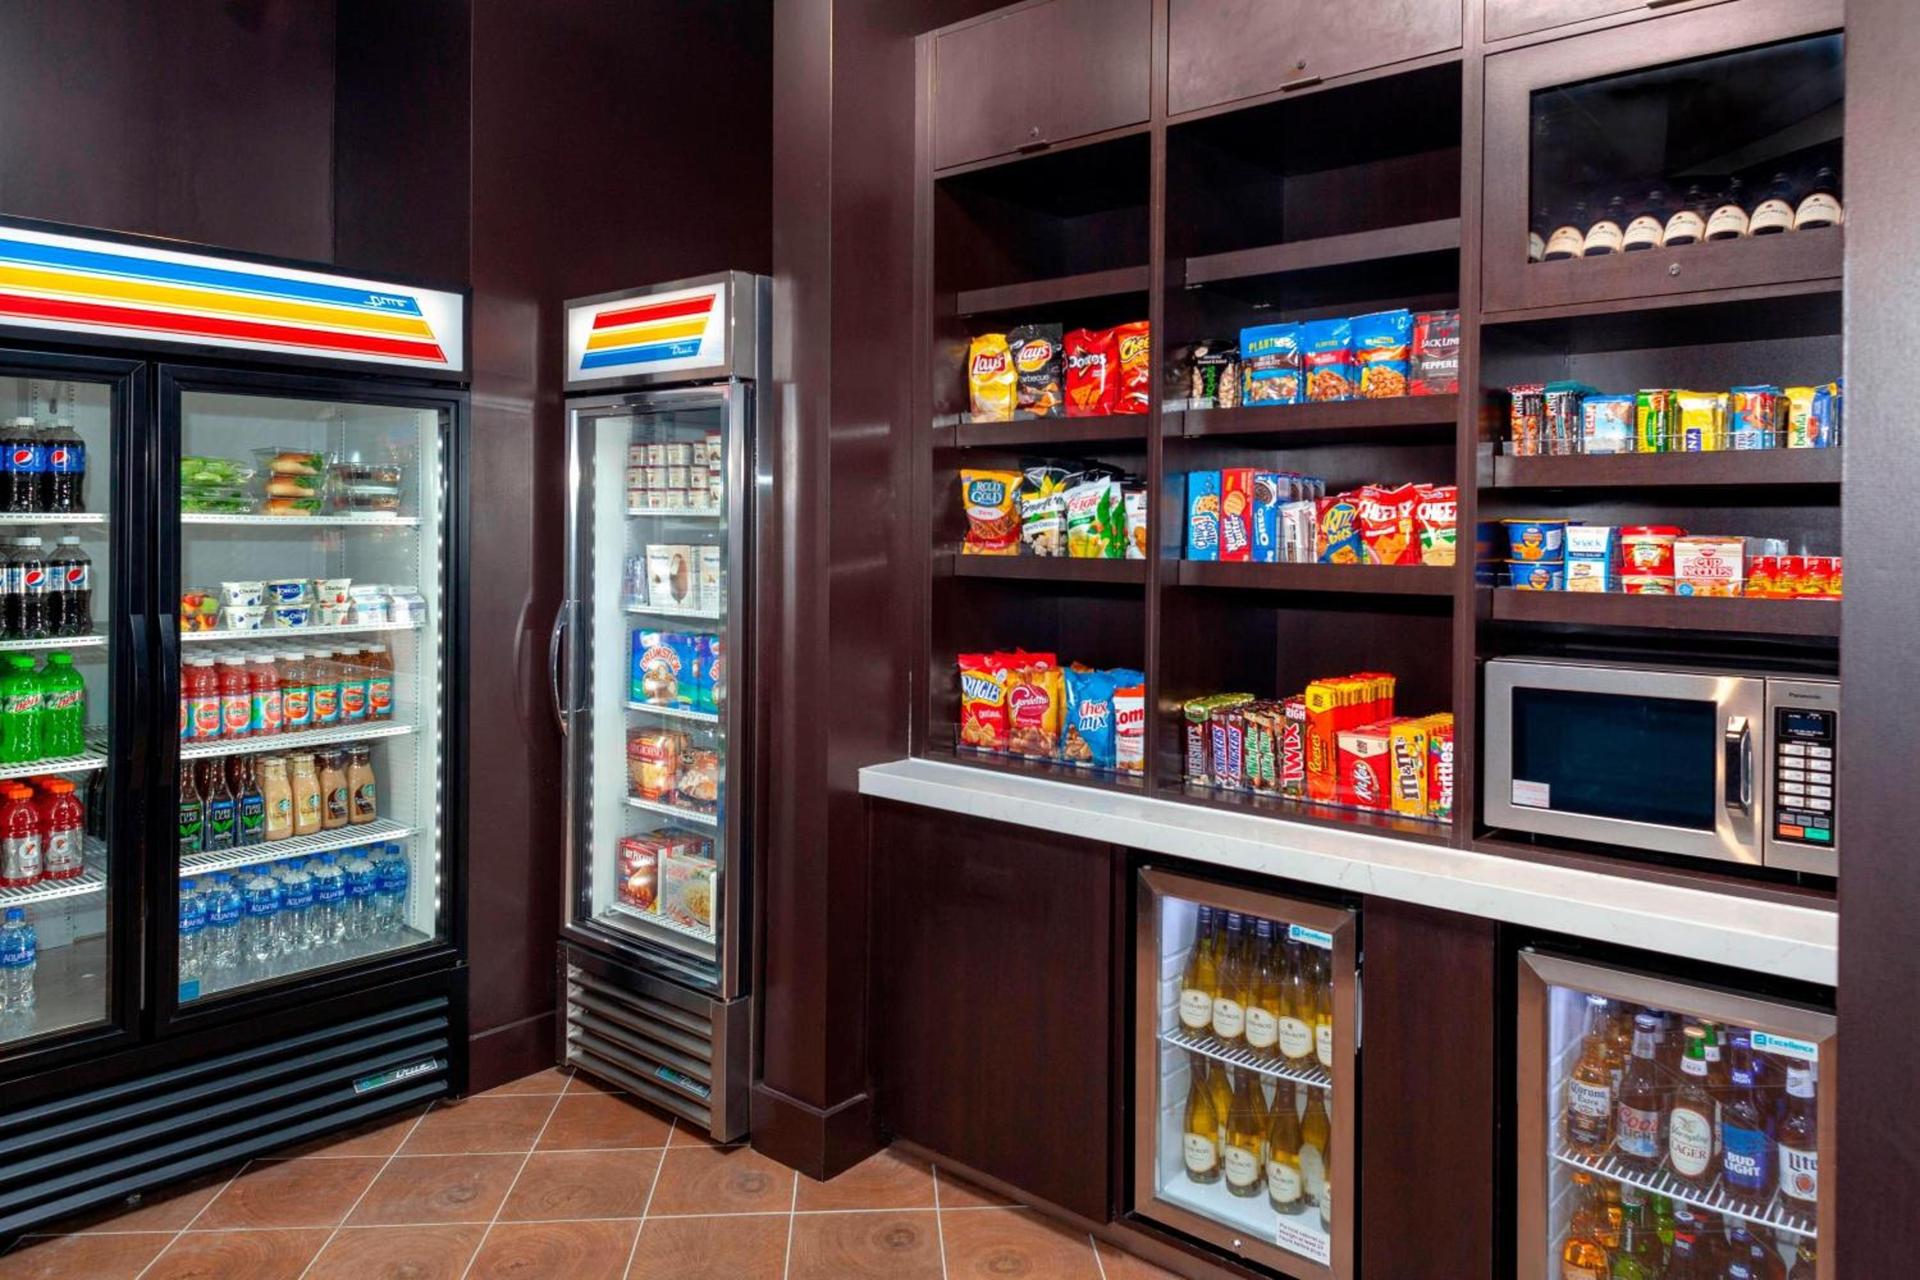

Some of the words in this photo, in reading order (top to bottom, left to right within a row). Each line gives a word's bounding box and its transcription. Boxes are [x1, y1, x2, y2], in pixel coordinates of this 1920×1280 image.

[1768, 1037, 1815, 1054] Excellence
[1724, 1158, 1761, 1177] LIGHT
[1727, 1151, 1756, 1167] BUD
